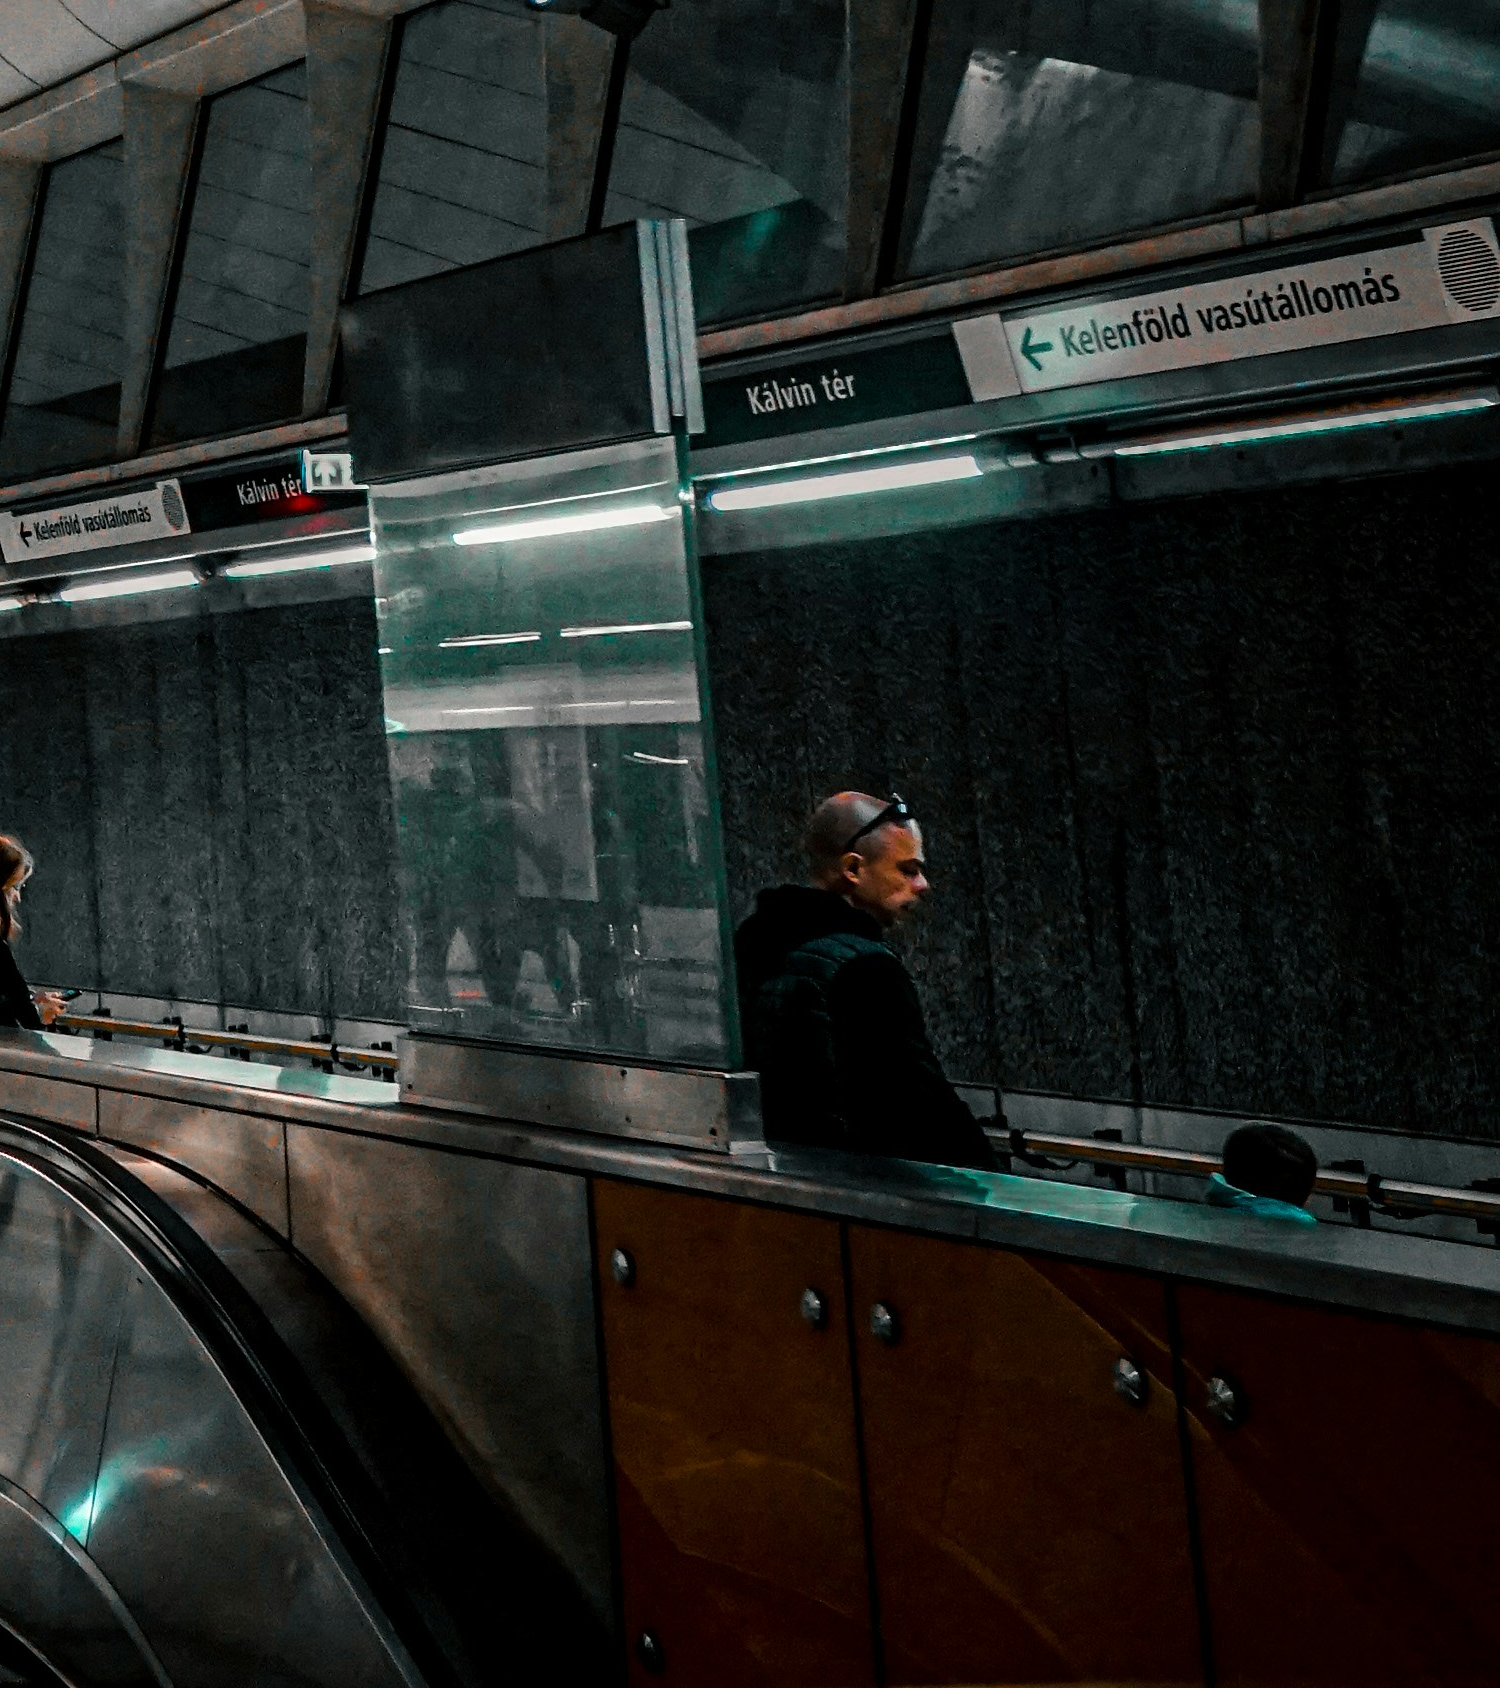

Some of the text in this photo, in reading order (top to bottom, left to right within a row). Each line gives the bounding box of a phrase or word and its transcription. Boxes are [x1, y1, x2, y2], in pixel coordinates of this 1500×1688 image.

[1058, 266, 1400, 359] Kelenföld vasútállomás
[746, 368, 856, 415] Kálvin tér
[237, 479, 279, 505] Kálvin
[33, 501, 151, 542] Kelenföld vasútállomás
